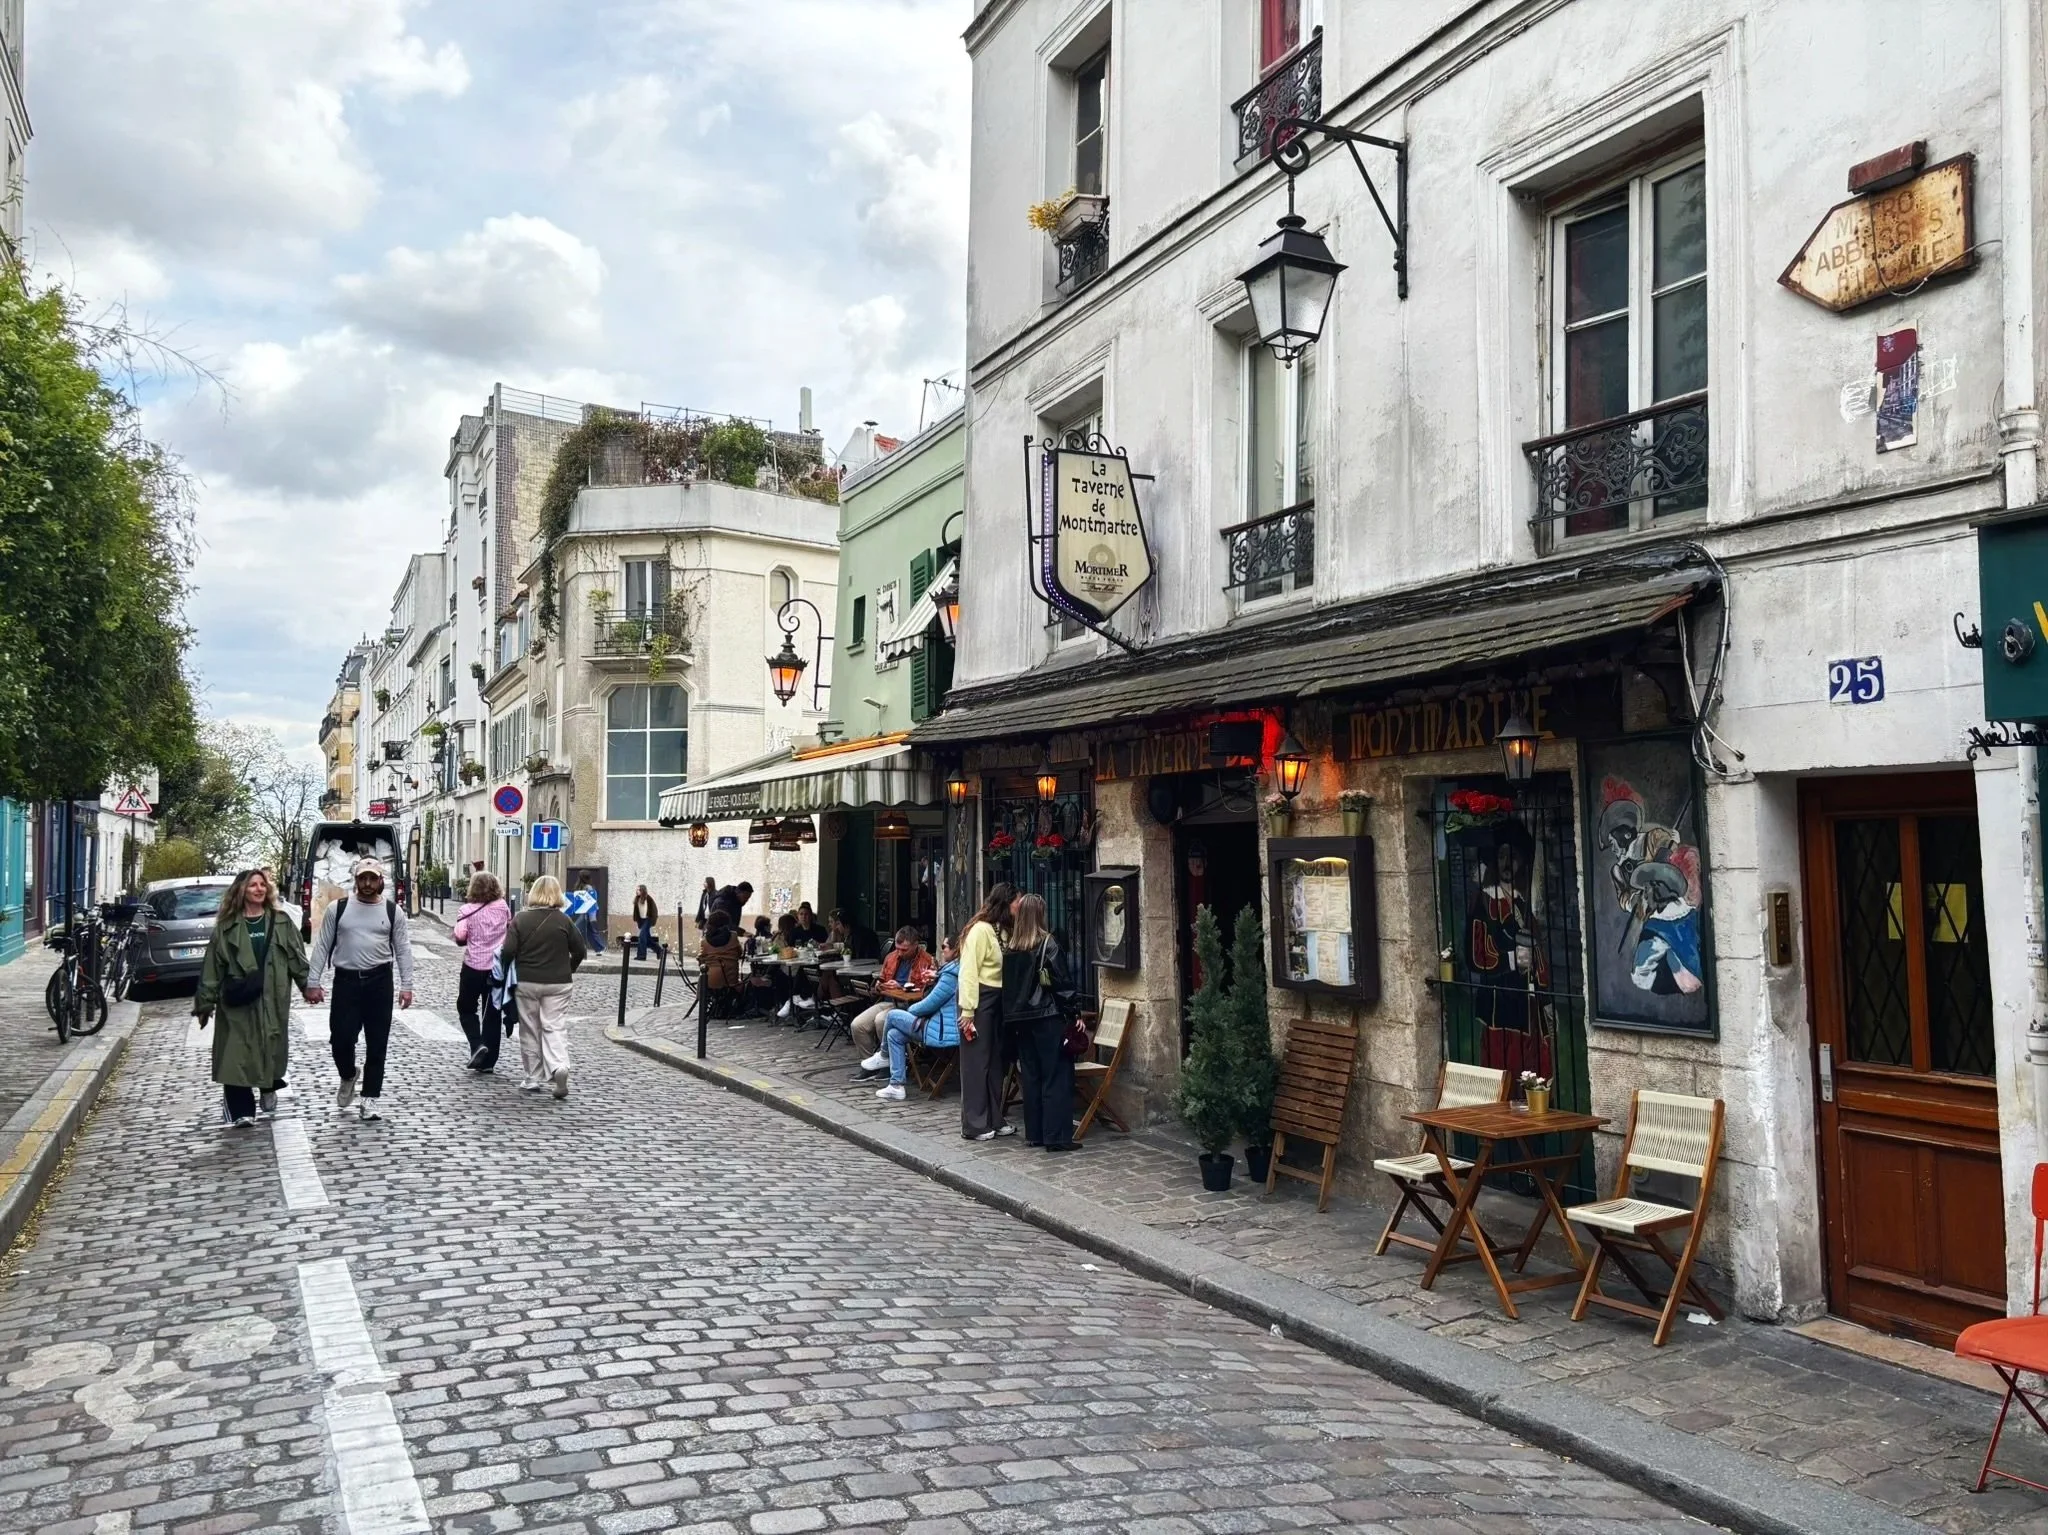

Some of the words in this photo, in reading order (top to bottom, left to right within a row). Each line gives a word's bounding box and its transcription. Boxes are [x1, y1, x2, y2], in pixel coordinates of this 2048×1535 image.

[1092, 460, 1106, 477] La
[1072, 478, 1124, 498] Taverne
[1092, 499, 1106, 517] de
[1059, 515, 1138, 536] Montmartre
[1830, 660, 1880, 702] 25
